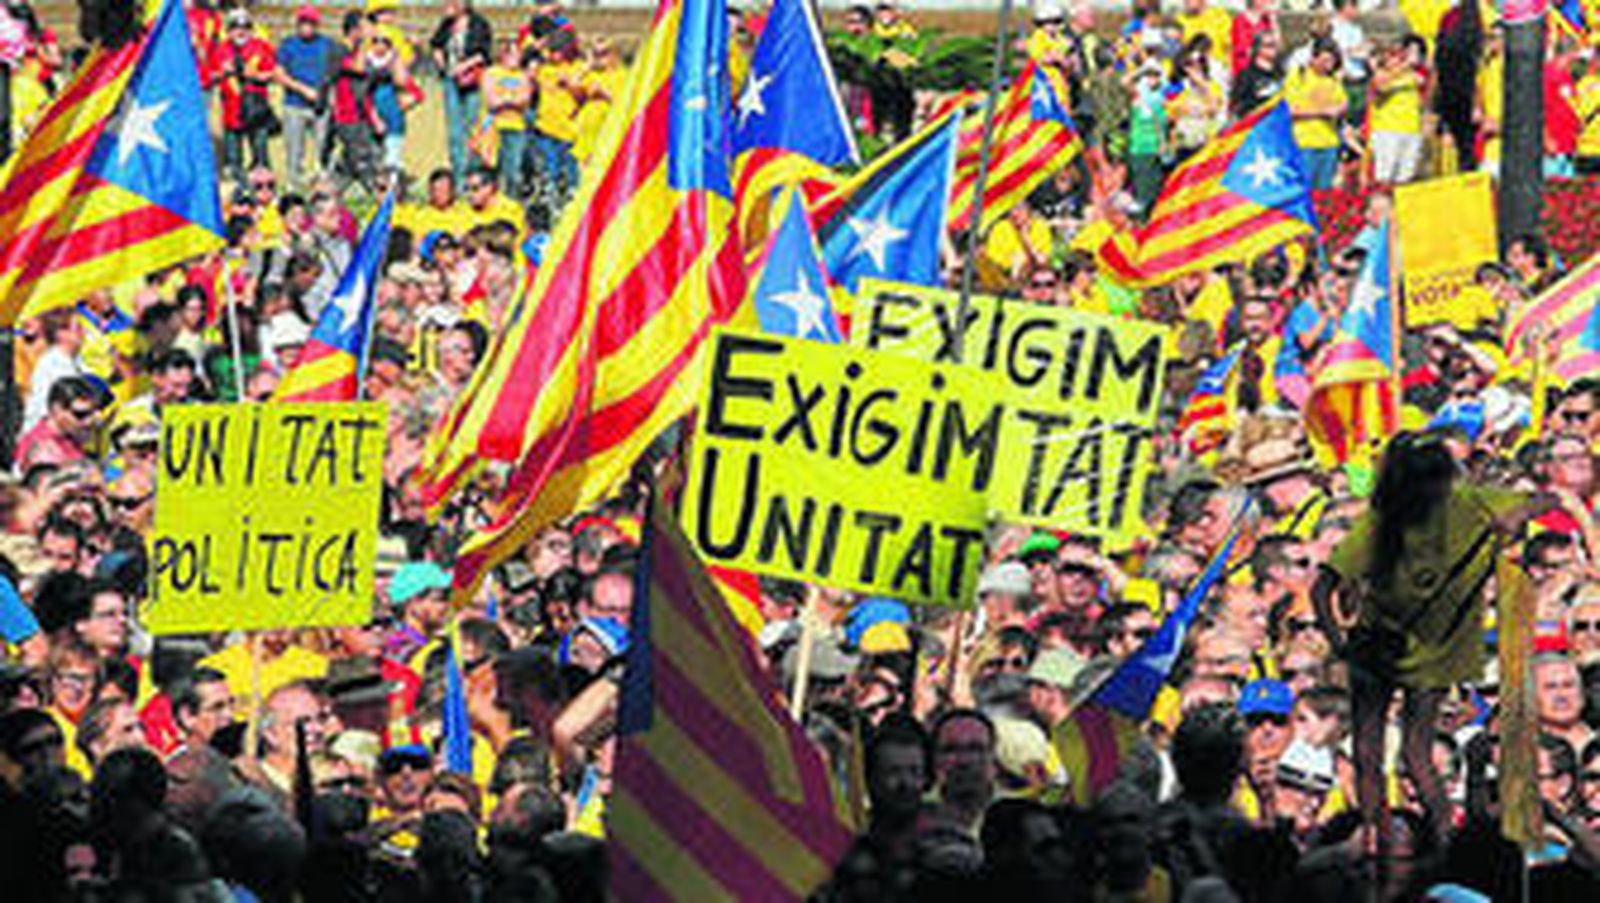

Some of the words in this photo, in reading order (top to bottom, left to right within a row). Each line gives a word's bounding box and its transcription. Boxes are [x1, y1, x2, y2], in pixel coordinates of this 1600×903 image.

[164, 412, 378, 486] UNITAT
[1016, 409, 1152, 528] TAT
[697, 446, 983, 598] UNITAT
